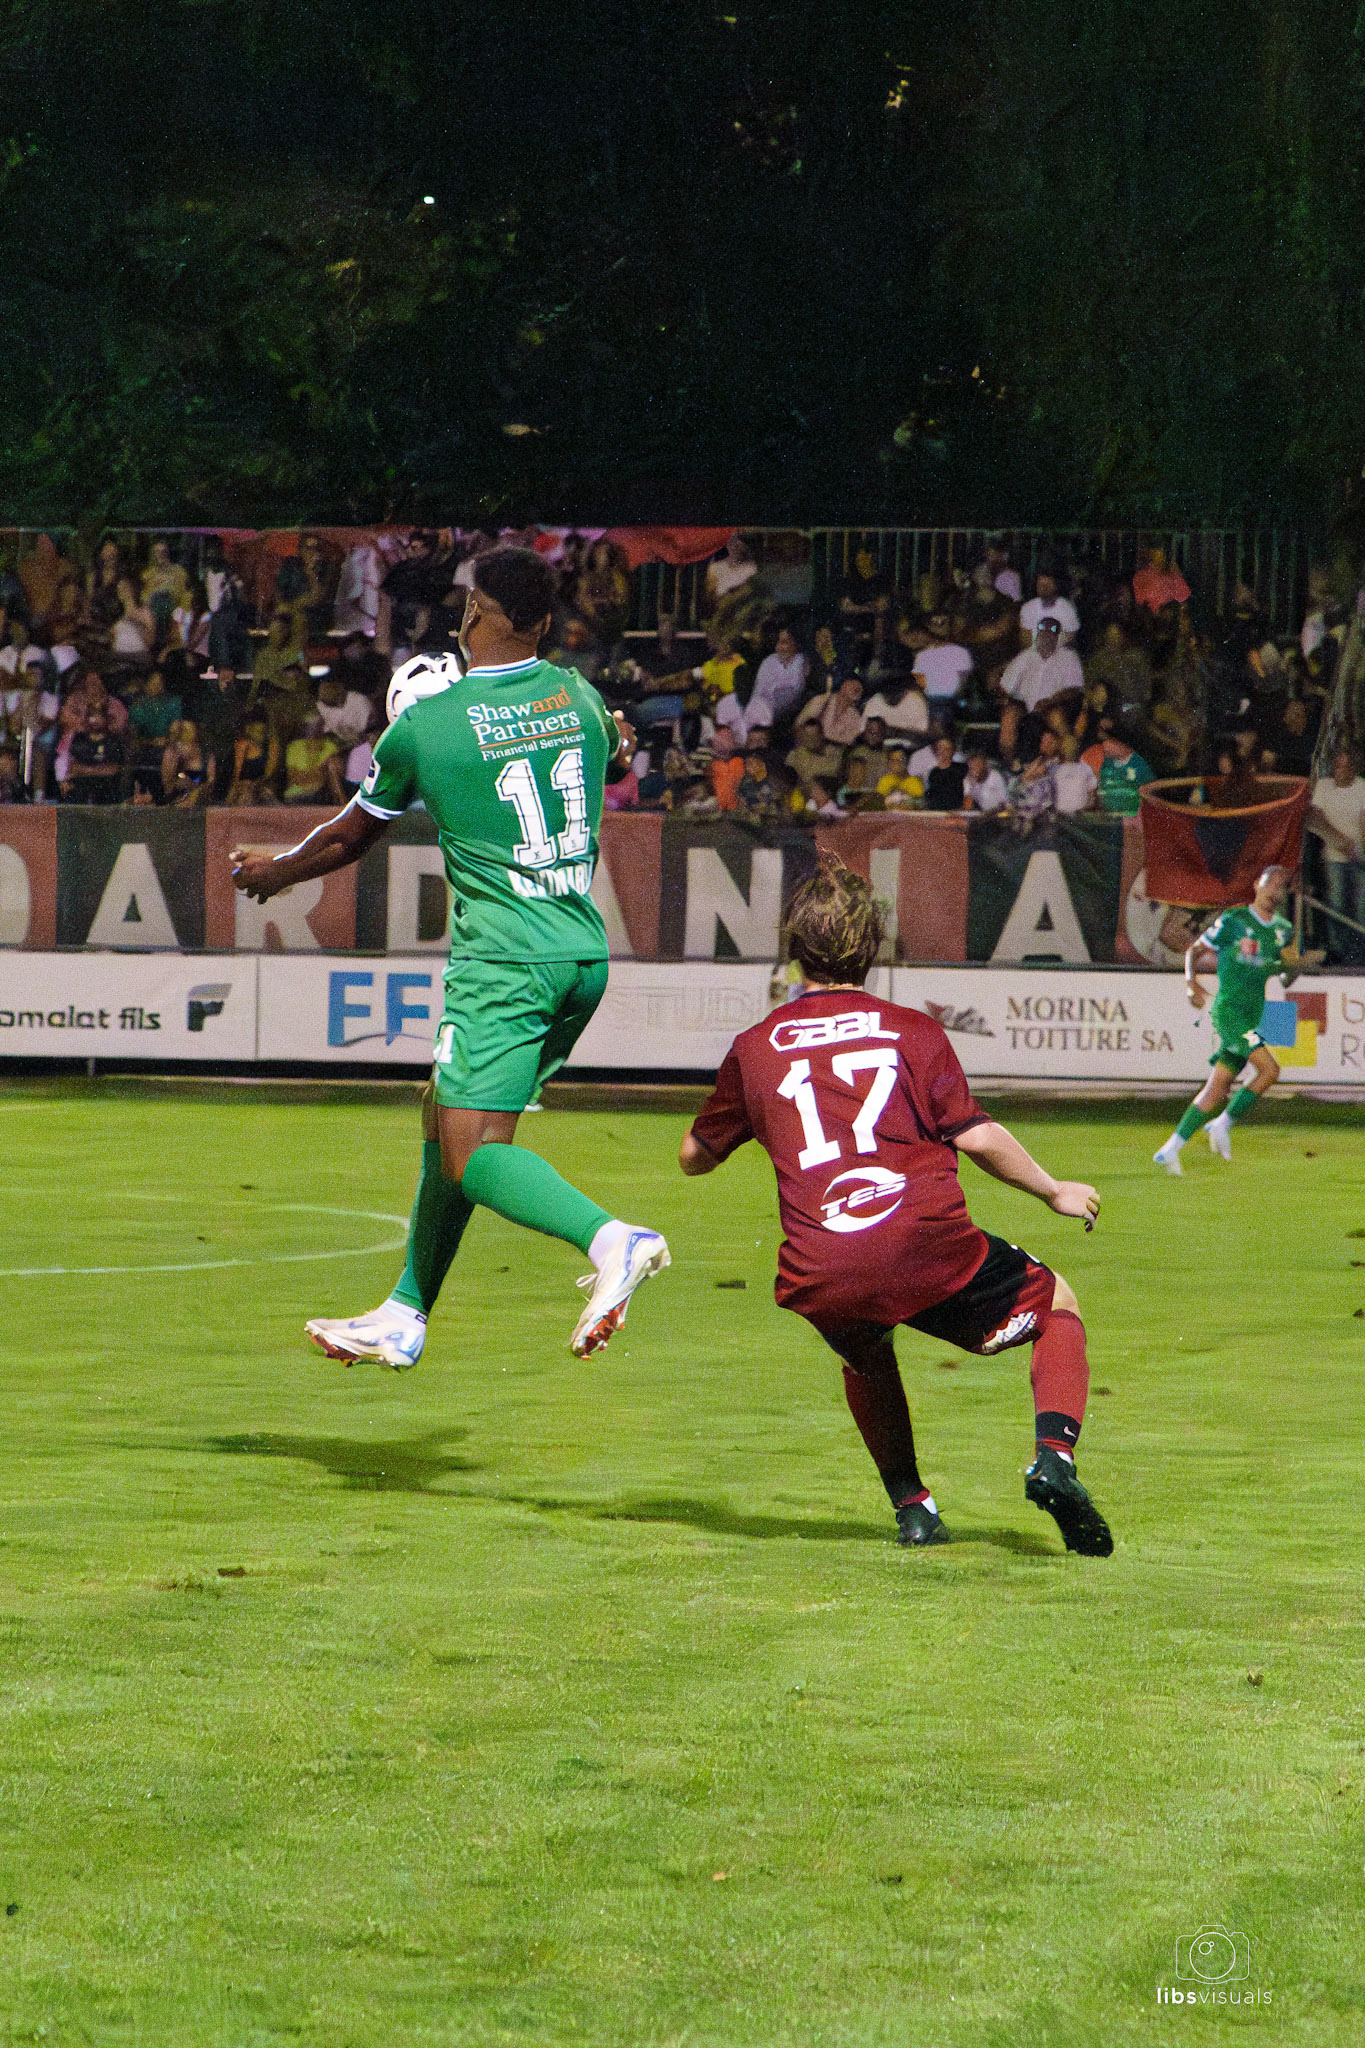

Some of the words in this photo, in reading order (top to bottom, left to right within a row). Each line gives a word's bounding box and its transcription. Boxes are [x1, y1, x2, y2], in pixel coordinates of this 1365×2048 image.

[473, 711, 581, 745] Partners
[481, 741, 539, 761] Financial
[540, 733, 586, 750] Services
[494, 747, 591, 868] 11
[119, 1007, 161, 1030] fils
[1005, 997, 1129, 1022] MORINA
[768, 1011, 901, 1053] GBBL
[1005, 1025, 1131, 1051] TOITURE
[1141, 1030, 1174, 1052] SA
[776, 1048, 899, 1170] 17
